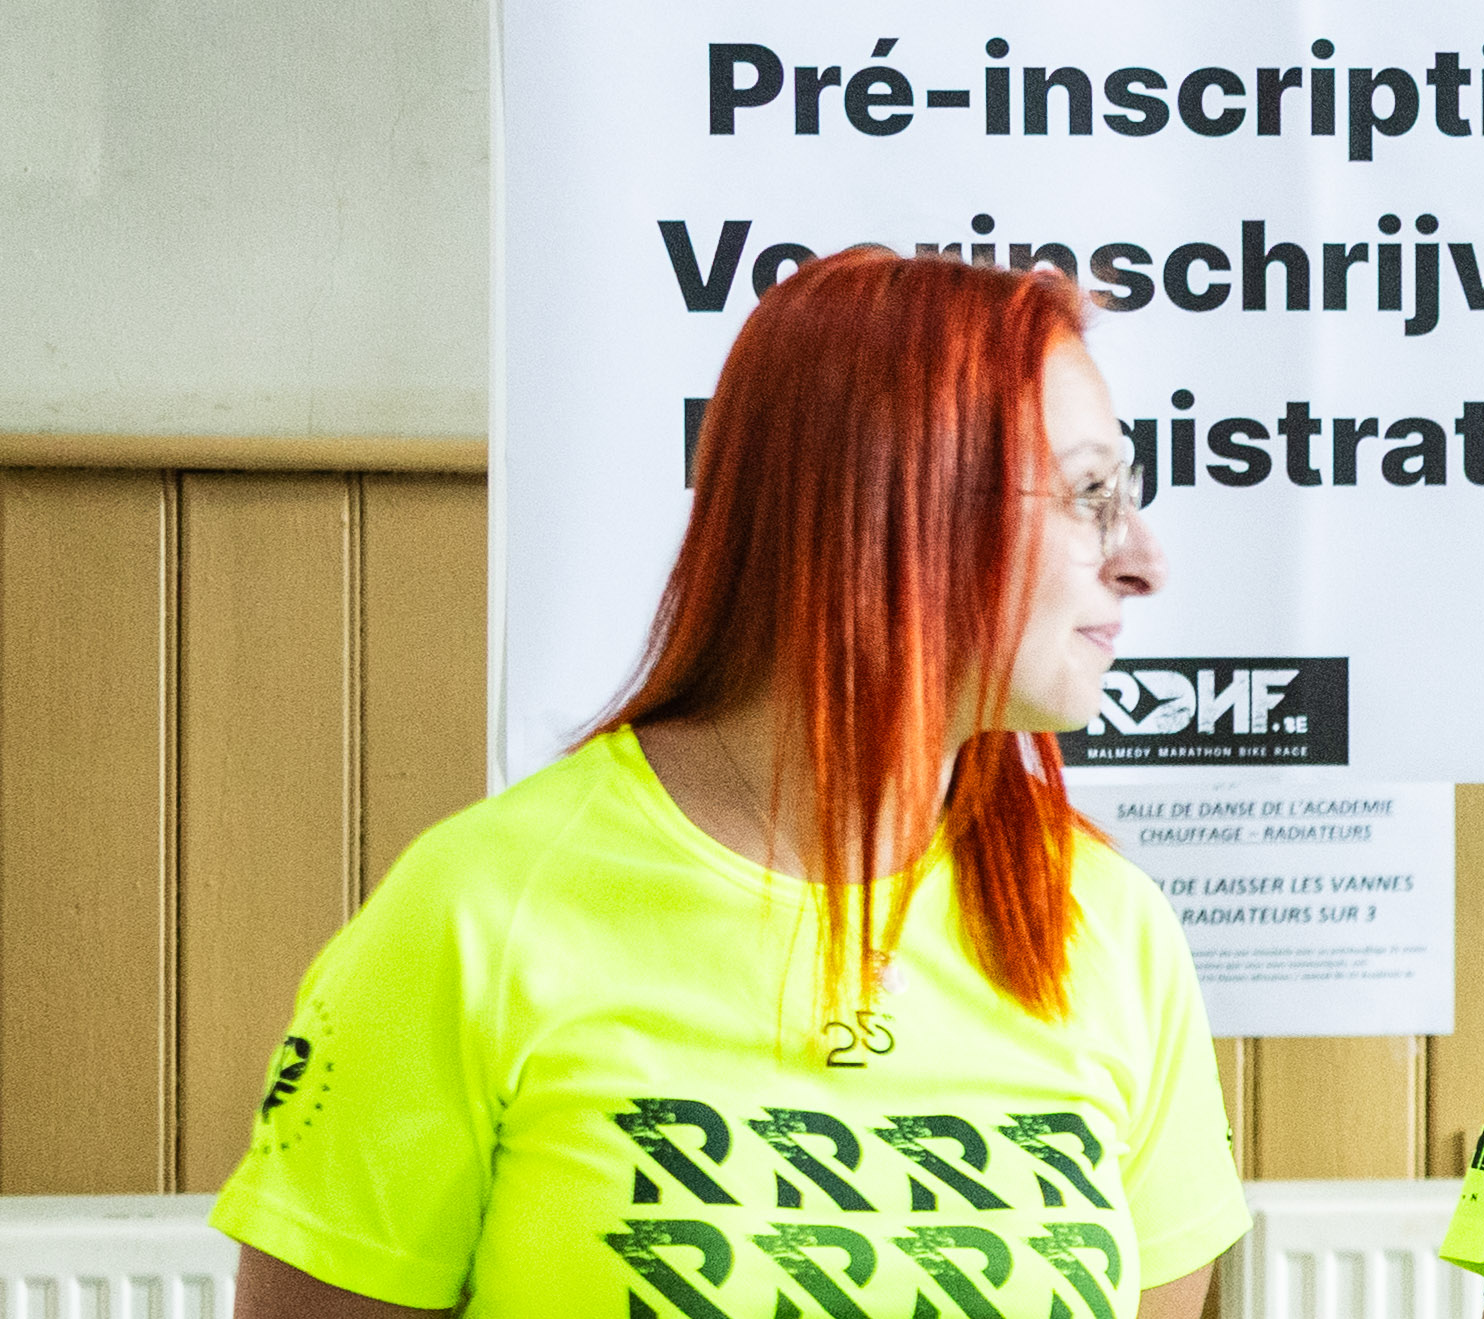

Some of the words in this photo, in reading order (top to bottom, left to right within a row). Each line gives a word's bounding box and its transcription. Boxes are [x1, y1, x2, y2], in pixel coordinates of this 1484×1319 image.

[1087, 747, 1151, 759] MALMEDY
[1158, 746, 1232, 758] MARATHON
[1238, 746, 1267, 757] BIKE
[1117, 802, 1164, 819] SALLE
[1171, 801, 1193, 818] DE
[1199, 800, 1255, 817] DANSE
[1261, 800, 1284, 817] DE
[1139, 827, 1242, 844] CHAUFFAGE
[1262, 824, 1372, 841] RADIATEURS
[1170, 878, 1196, 896] DE
[1203, 877, 1284, 896] LAISSER
[1290, 876, 1323, 894] LES
[1330, 874, 1415, 893] VANNES
[1181, 907, 1312, 926] RADIATEURS
[1317, 906, 1359, 923] SUR
